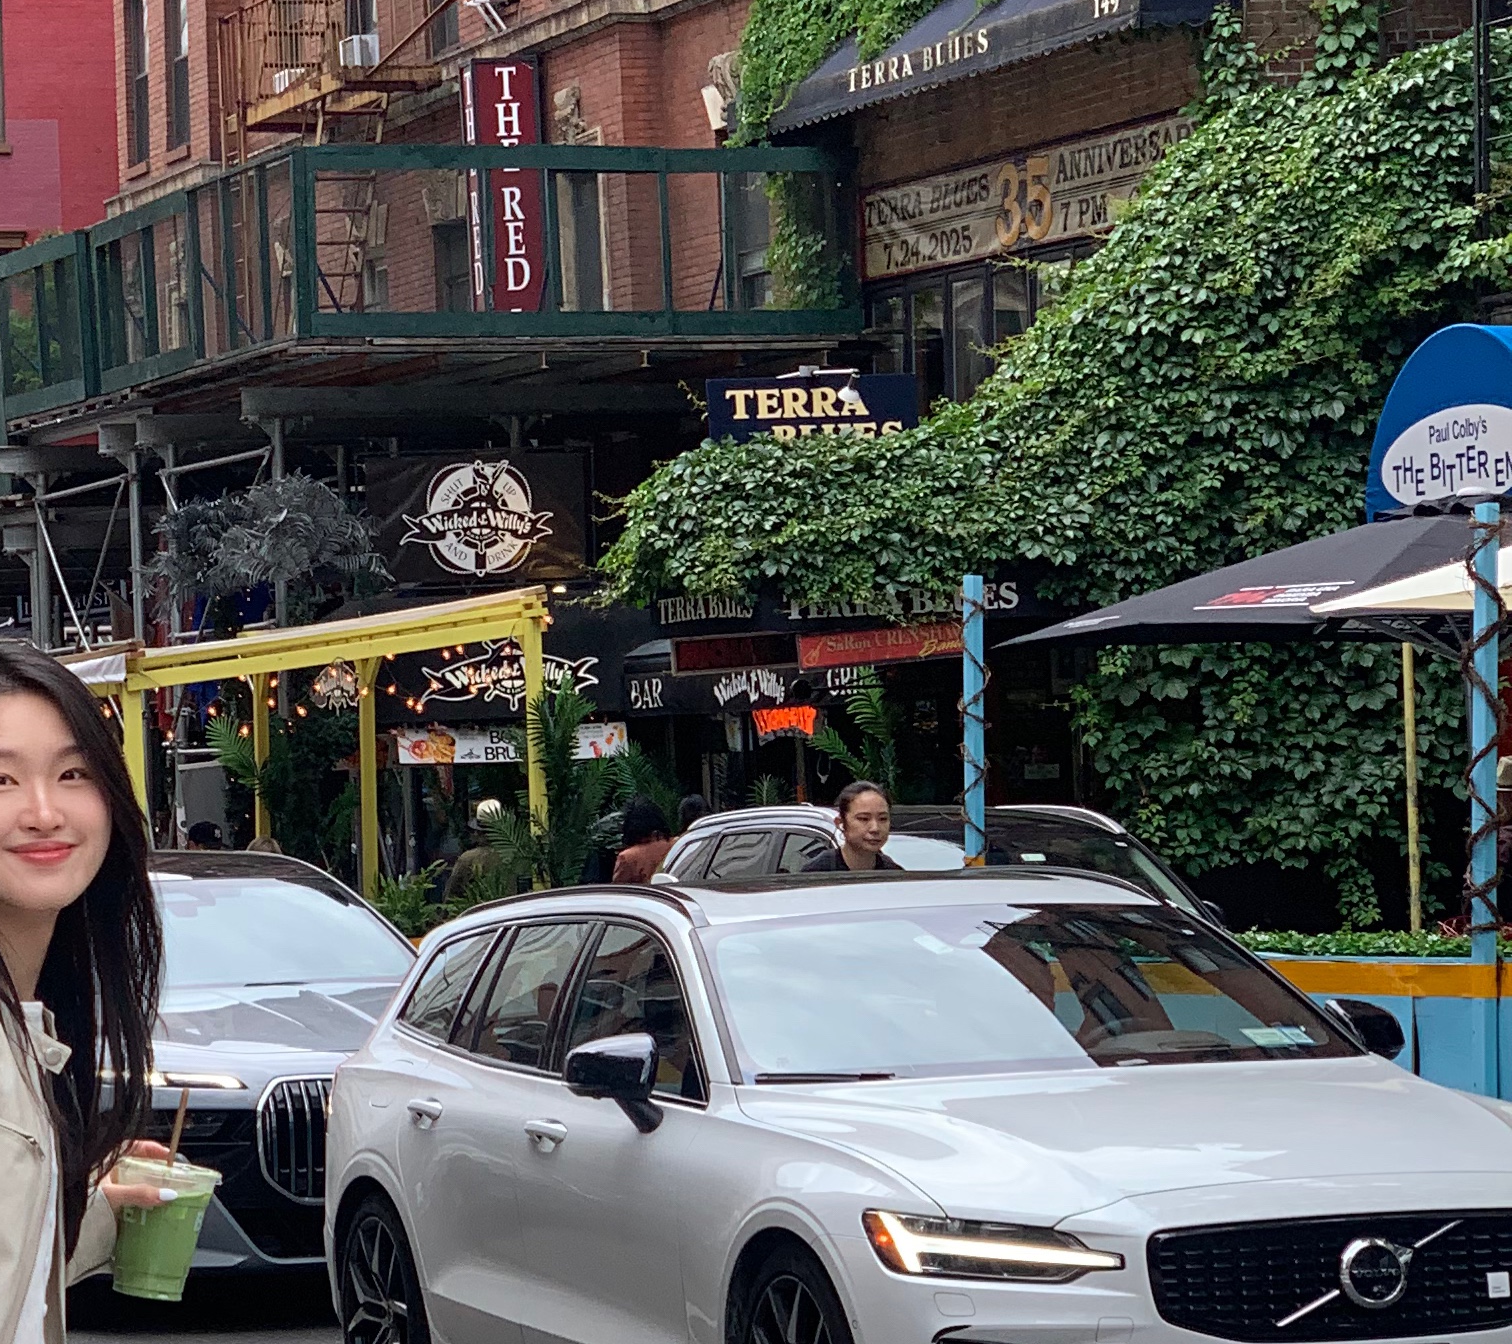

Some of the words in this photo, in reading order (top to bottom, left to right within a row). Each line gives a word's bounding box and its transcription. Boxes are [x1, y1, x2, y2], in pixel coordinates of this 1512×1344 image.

[847, 53, 914, 93] TERRA
[922, 28, 989, 72] BLUES
[864, 189, 925, 228] TERRA
[929, 172, 989, 215] BLUES
[995, 155, 1053, 247] 35
[1059, 201, 1072, 232] 7
[1078, 193, 1108, 227] PM
[501, 186, 531, 292] RED
[883, 223, 973, 271] 7.24.2025
[1428, 422, 1450, 445] Paul
[1452, 415, 1488, 441] Colby's
[441, 478, 465, 505] SHUT
[502, 481, 517, 497] UP
[1392, 456, 1426, 496] THE
[1430, 444, 1490, 493] BITTER
[422, 511, 478, 534] Wicked
[487, 508, 532, 535] Willy's
[444, 541, 468, 562] AND
[487, 542, 519, 565] DRINK
[630, 677, 664, 709] BAR
